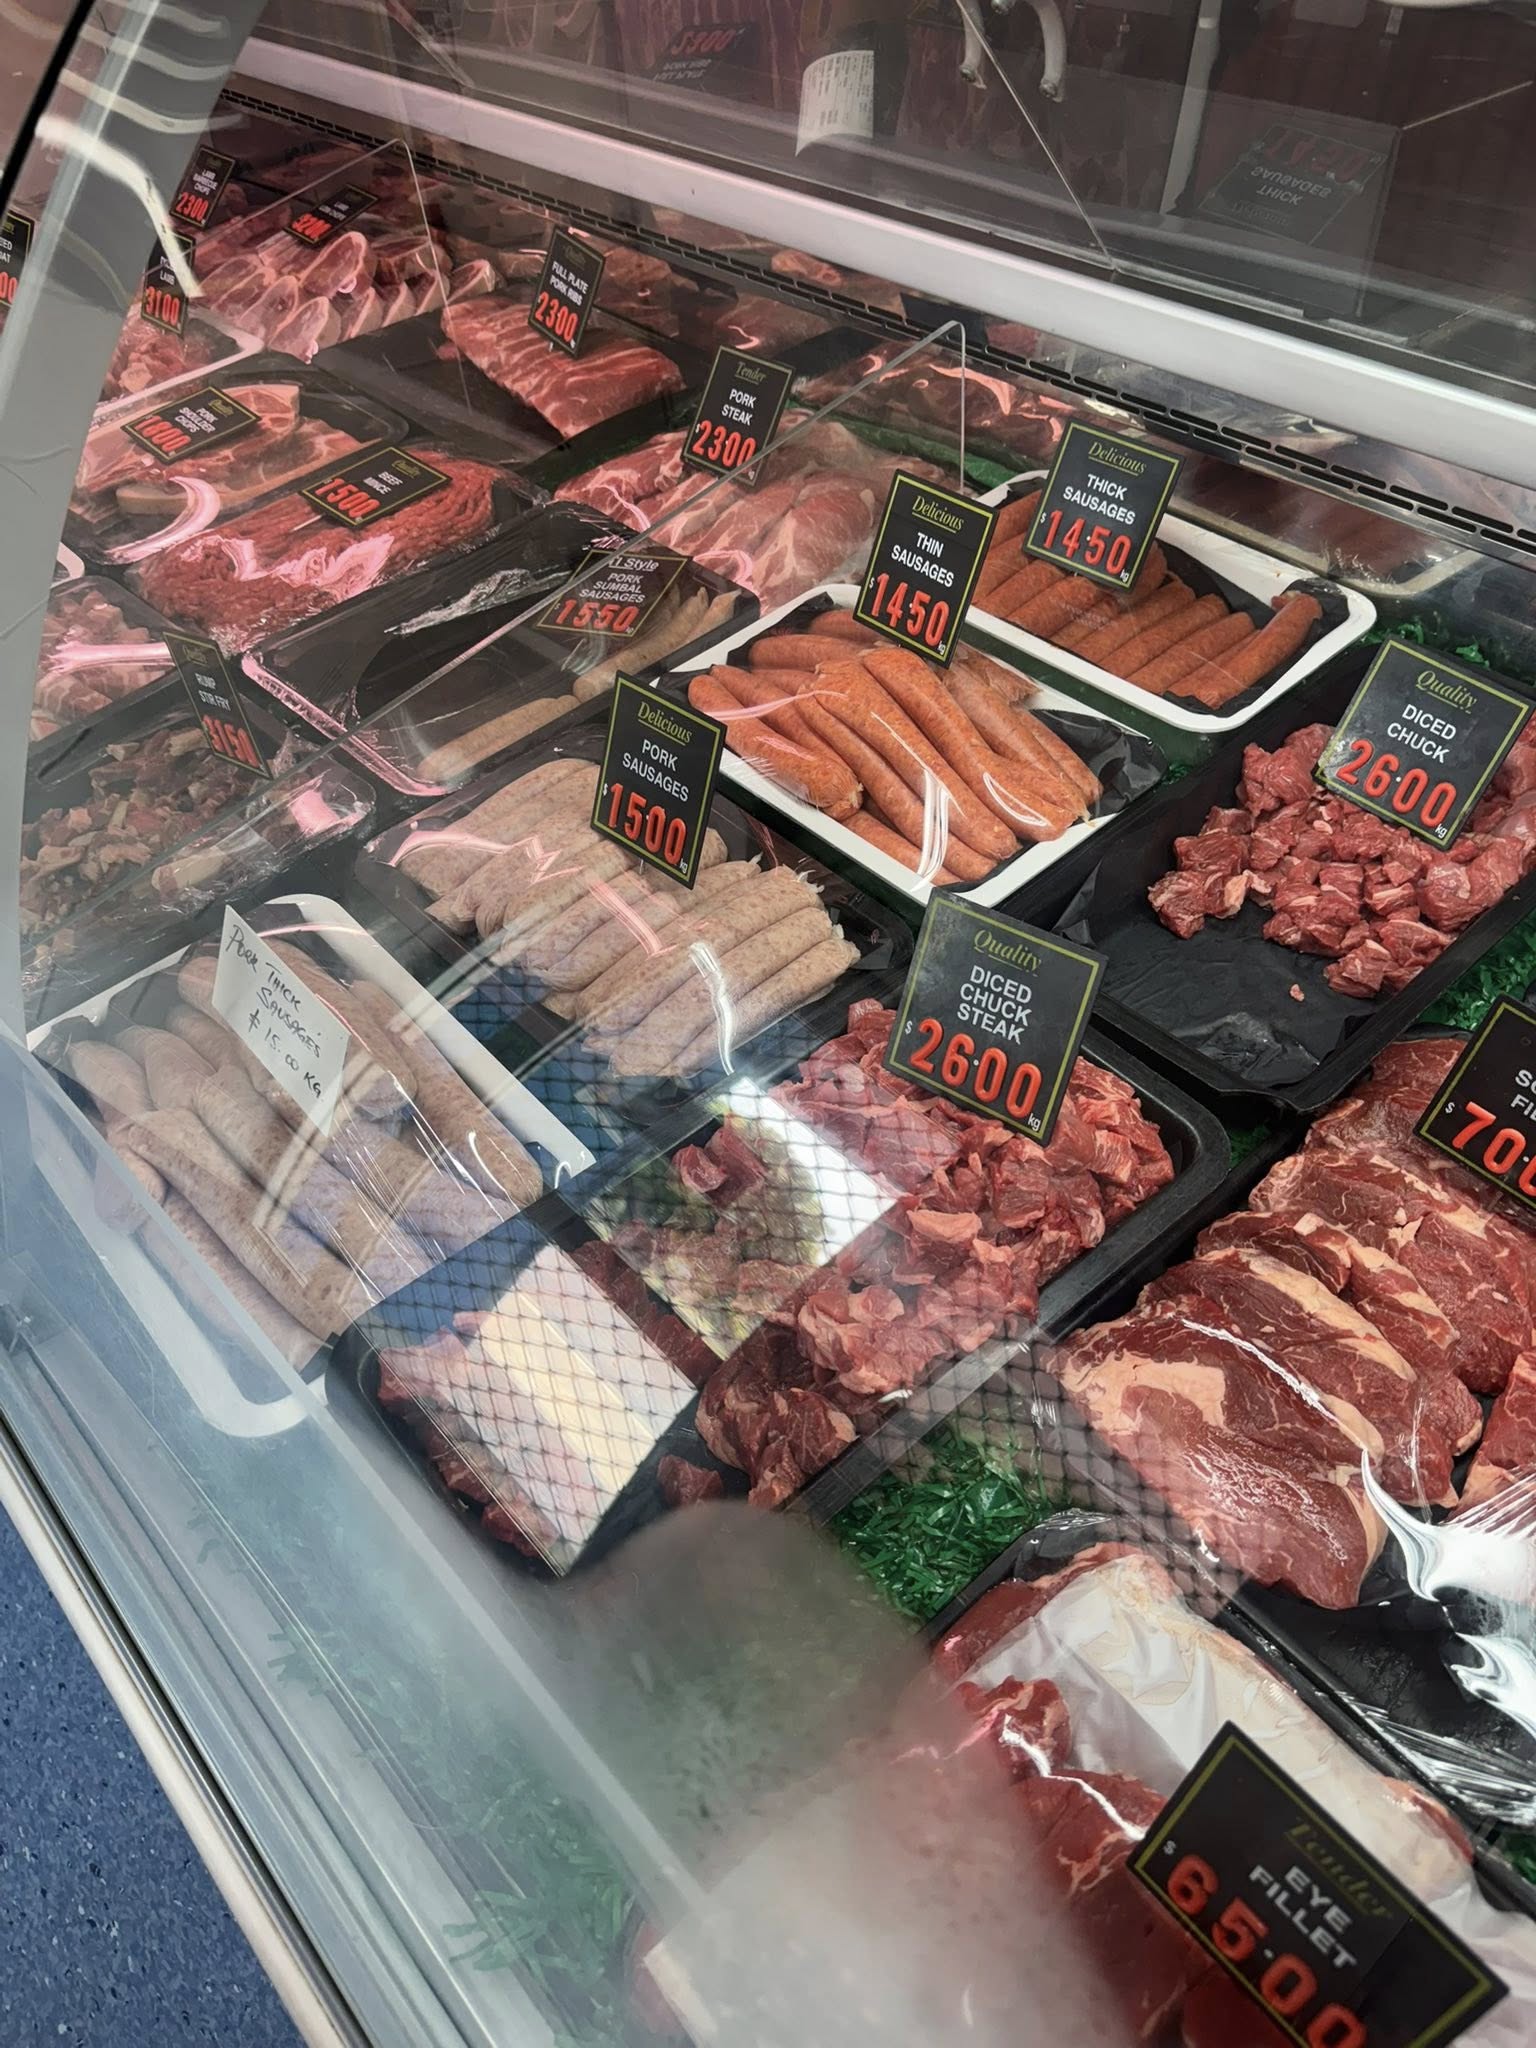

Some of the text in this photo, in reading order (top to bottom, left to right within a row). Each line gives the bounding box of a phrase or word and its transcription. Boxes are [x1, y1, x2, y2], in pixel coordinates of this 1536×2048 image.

[722, 404, 753, 426] STEAK
[729, 388, 757, 408] PORK
[1088, 442, 1147, 474] Delicious
[378, 471, 403, 486] BEEF
[1087, 474, 1128, 500] THICK
[912, 495, 964, 532] Delicious
[1063, 486, 1136, 526] SAUSAGES
[916, 532, 944, 558] THIN
[608, 573, 644, 584] PORK
[624, 558, 659, 572] Style
[892, 545, 954, 588] SAUSAGES
[579, 589, 646, 603] SAUSAGES
[593, 581, 642, 594] SUMBAL
[1415, 670, 1478, 709] Quality
[638, 701, 693, 743] Delicious
[1402, 704, 1457, 740] DICED
[642, 739, 678, 772] PORK
[1387, 722, 1450, 764] CHUCK
[622, 752, 689, 802] SAUSAGES
[974, 929, 1042, 972] Quality
[266, 962, 301, 1014] THICK
[970, 965, 1032, 1003] DICED
[256, 986, 320, 1058] SAUSAGES
[957, 1002, 1025, 1044] STEAK
[960, 983, 1032, 1026] CHUCK
[1248, 1864, 1358, 1970] FILLET
[1284, 1866, 1354, 1934] EYE
